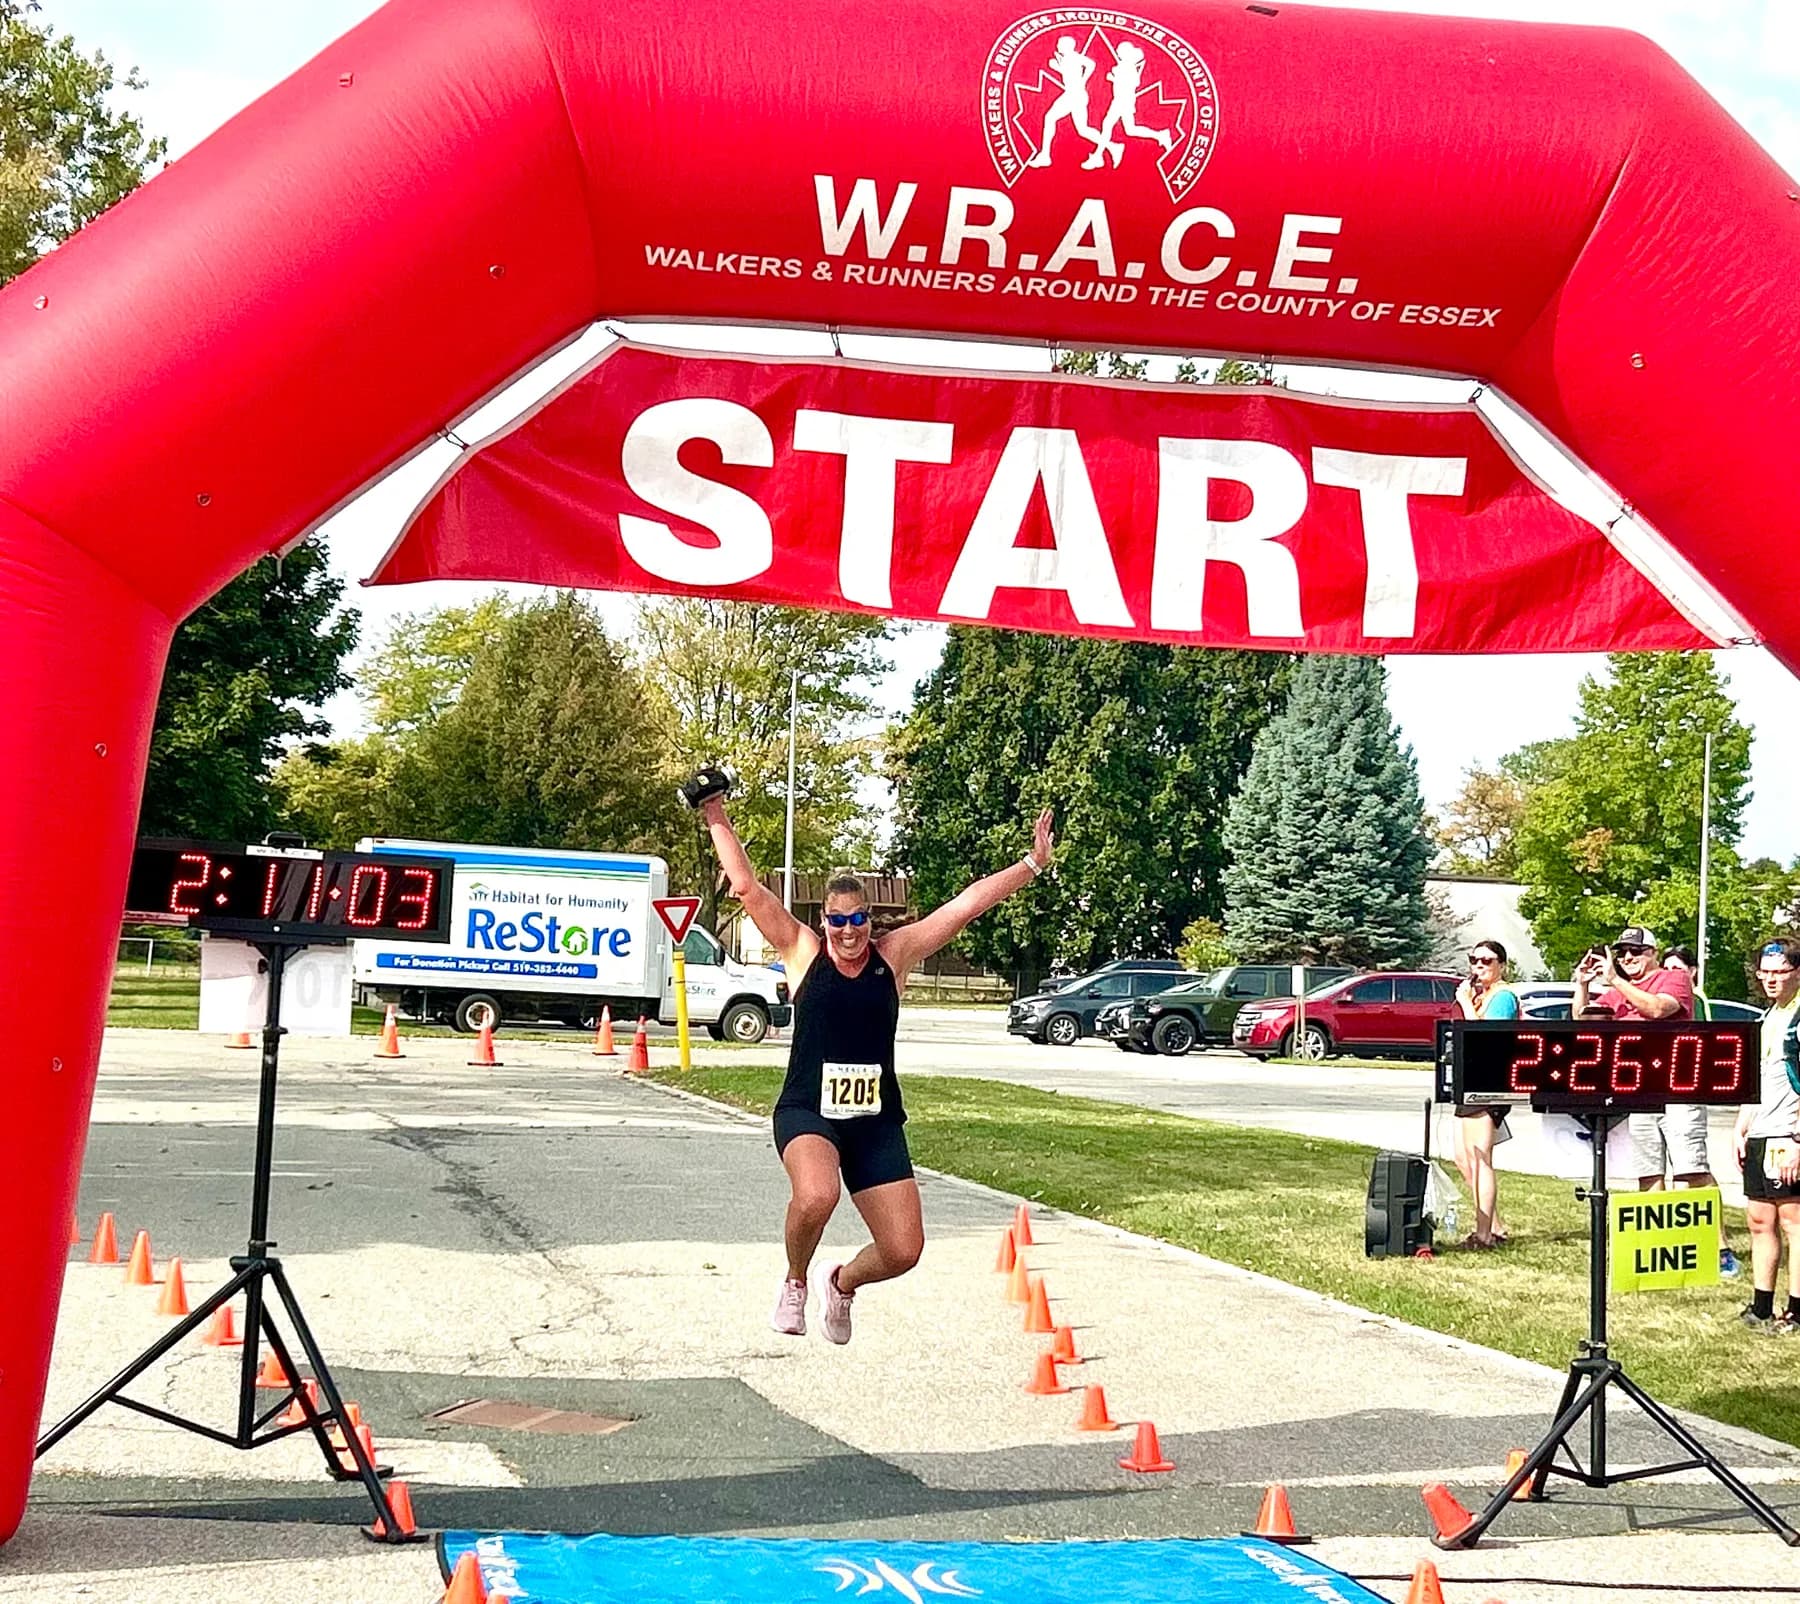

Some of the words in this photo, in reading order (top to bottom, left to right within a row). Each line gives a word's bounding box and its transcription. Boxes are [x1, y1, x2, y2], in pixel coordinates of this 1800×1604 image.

[1055, 11, 1127, 26] AROUND
[1133, 20, 1166, 44] THE
[994, 16, 1052, 67] RUNNERS
[1166, 39, 1212, 100] COUNTY
[987, 85, 1017, 175] WALKERS
[1199, 105, 1213, 130] OF
[1172, 134, 1210, 190] ESSEX
[814, 174, 1359, 294] W.R.A.C.E.
[644, 245, 802, 278] WALKERS
[812, 261, 833, 281] &
[843, 265, 995, 293] RUNNERS
[1002, 276, 1138, 303] AROUND
[1148, 286, 1208, 309] THE
[1215, 290, 1345, 316] COUNTY
[1350, 300, 1395, 321] OF
[1399, 305, 1502, 328] ESSEX
[617, 397, 1468, 638] START
[492, 889, 541, 905] Habitat
[545, 893, 564, 907] for
[568, 894, 629, 913] Humanity
[466, 908, 632, 957] ReStore
[394, 957, 411, 967] For
[412, 957, 456, 969] Donation
[458, 960, 490, 972] Pickup
[492, 962, 511, 972] Call
[829, 1077, 877, 1106] 1205
[1618, 1200, 1714, 1233] FINISH
[1634, 1244, 1698, 1274] LINE
